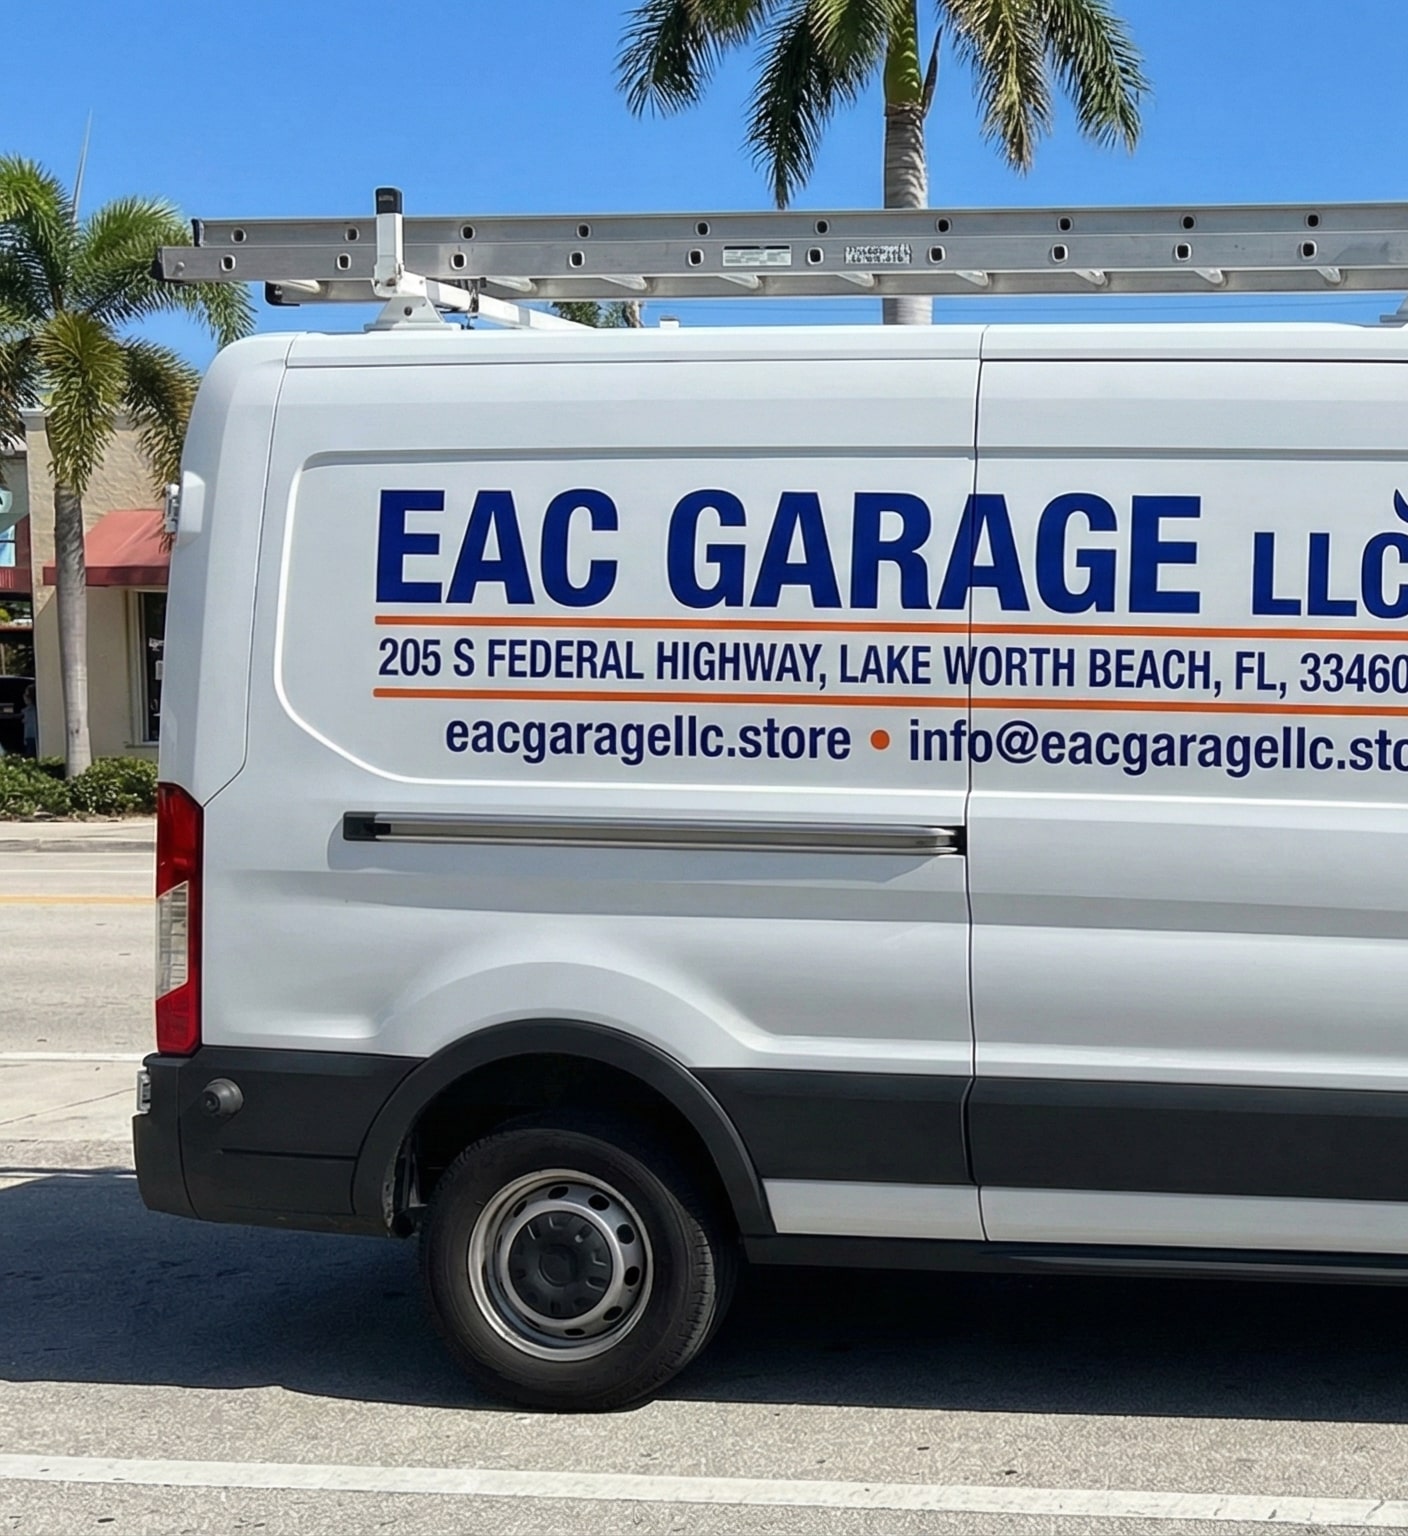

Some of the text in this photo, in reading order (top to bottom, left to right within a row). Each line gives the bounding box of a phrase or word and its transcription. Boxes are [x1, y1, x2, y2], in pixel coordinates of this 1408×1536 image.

[375, 488, 619, 608] EAC
[666, 488, 1201, 614] GARAGE
[378, 637, 442, 677] 205
[453, 637, 475, 677] S
[487, 638, 645, 680] FEDERAL
[656, 641, 827, 691] HIGHWAY,
[839, 644, 932, 685] LAKE
[943, 645, 1075, 687] WORTH
[1088, 648, 1222, 698] BEACH,
[1235, 651, 1287, 700] FL,
[446, 714, 851, 766] eacgaragellc.store
